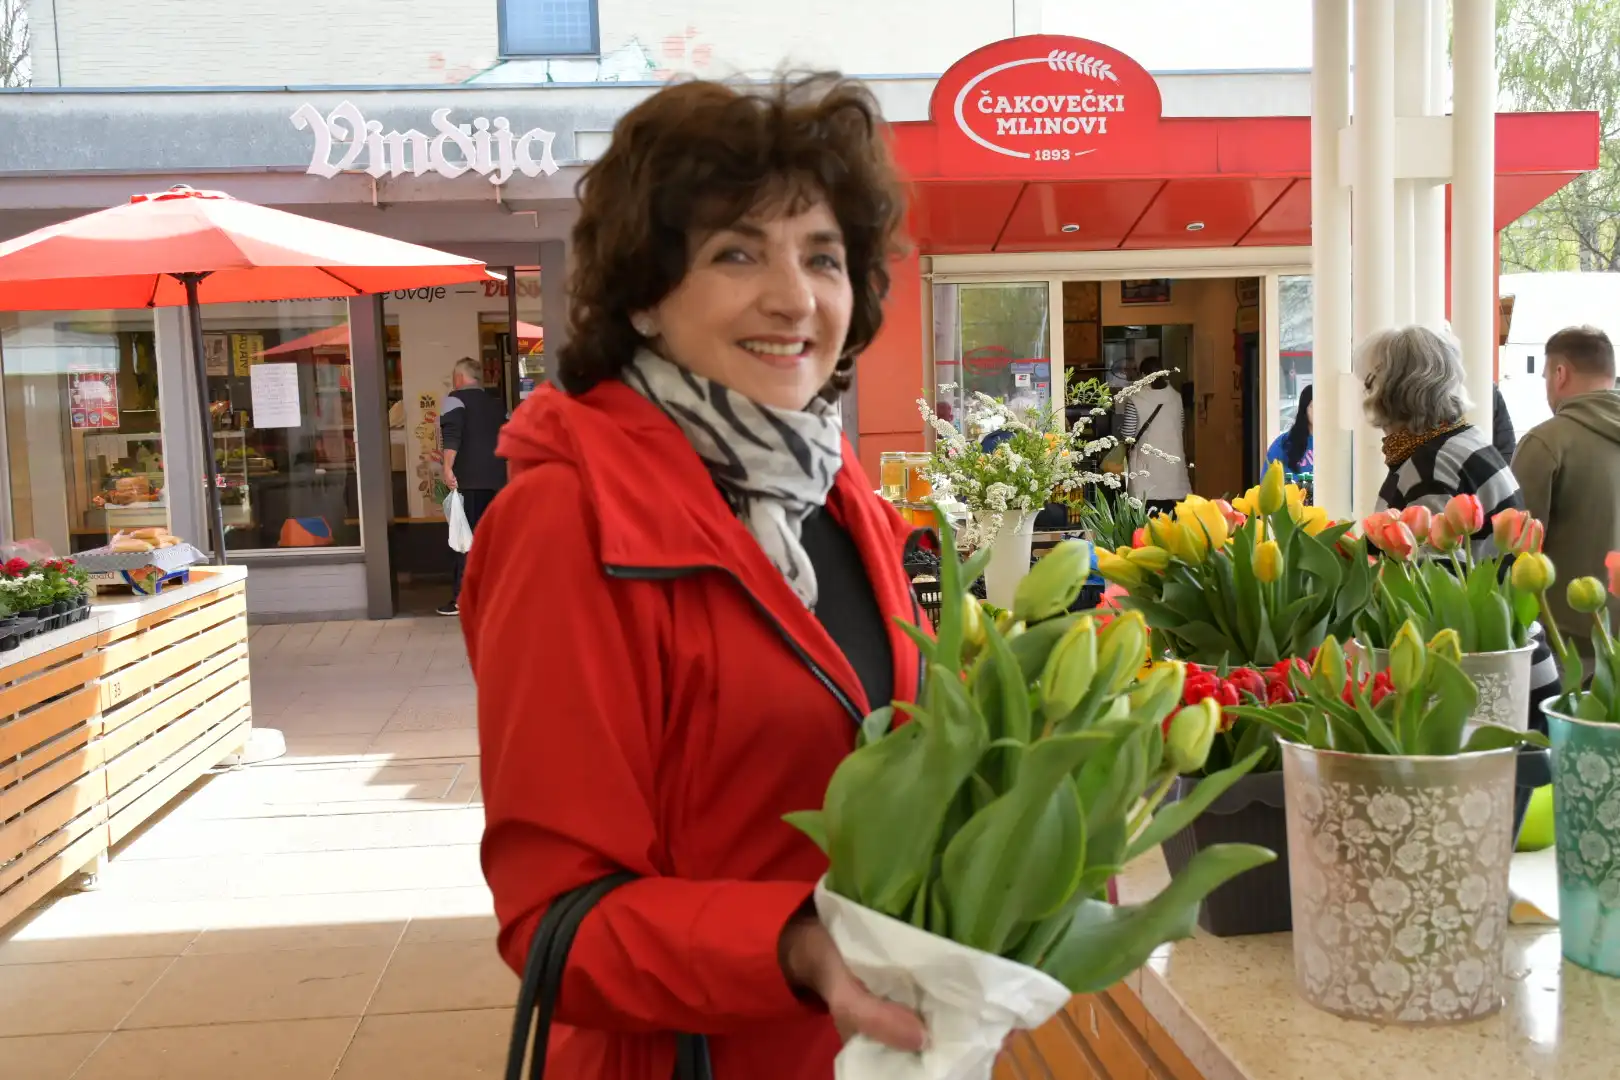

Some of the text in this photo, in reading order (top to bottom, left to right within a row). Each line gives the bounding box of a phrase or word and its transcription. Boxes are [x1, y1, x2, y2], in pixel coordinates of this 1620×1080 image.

[977, 88, 1125, 114] ČAKOVEČKI
[996, 116, 1108, 136] MLINOVI
[289, 99, 561, 186] Vindija
[1034, 149, 1071, 162] 1893
